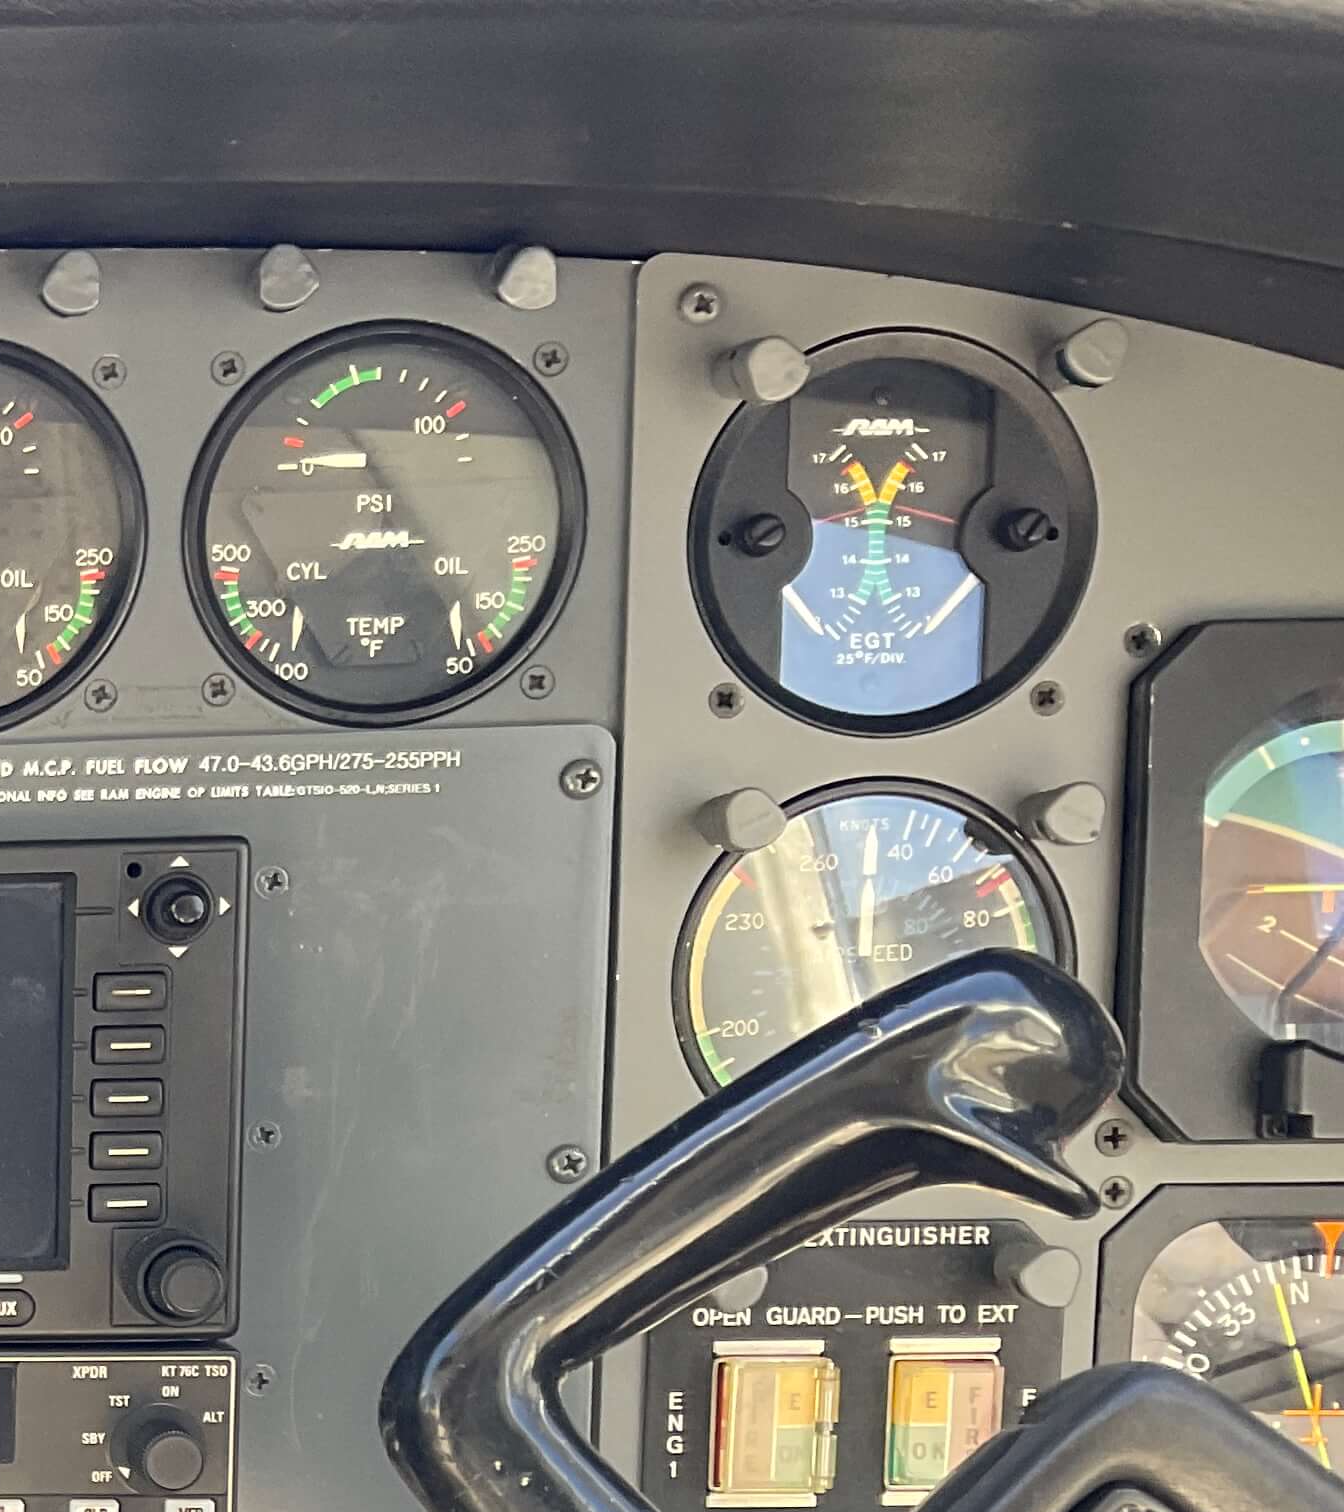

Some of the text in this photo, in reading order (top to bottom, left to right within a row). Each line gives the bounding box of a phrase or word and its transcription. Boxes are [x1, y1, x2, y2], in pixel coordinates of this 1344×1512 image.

[850, 632, 893, 651] EGT
[23, 760, 76, 777] M.C.P.
[86, 758, 125, 775] FUEL
[135, 758, 188, 775] FLOW
[938, 1305, 966, 1324] TO
[978, 1305, 1017, 1324] EXT
